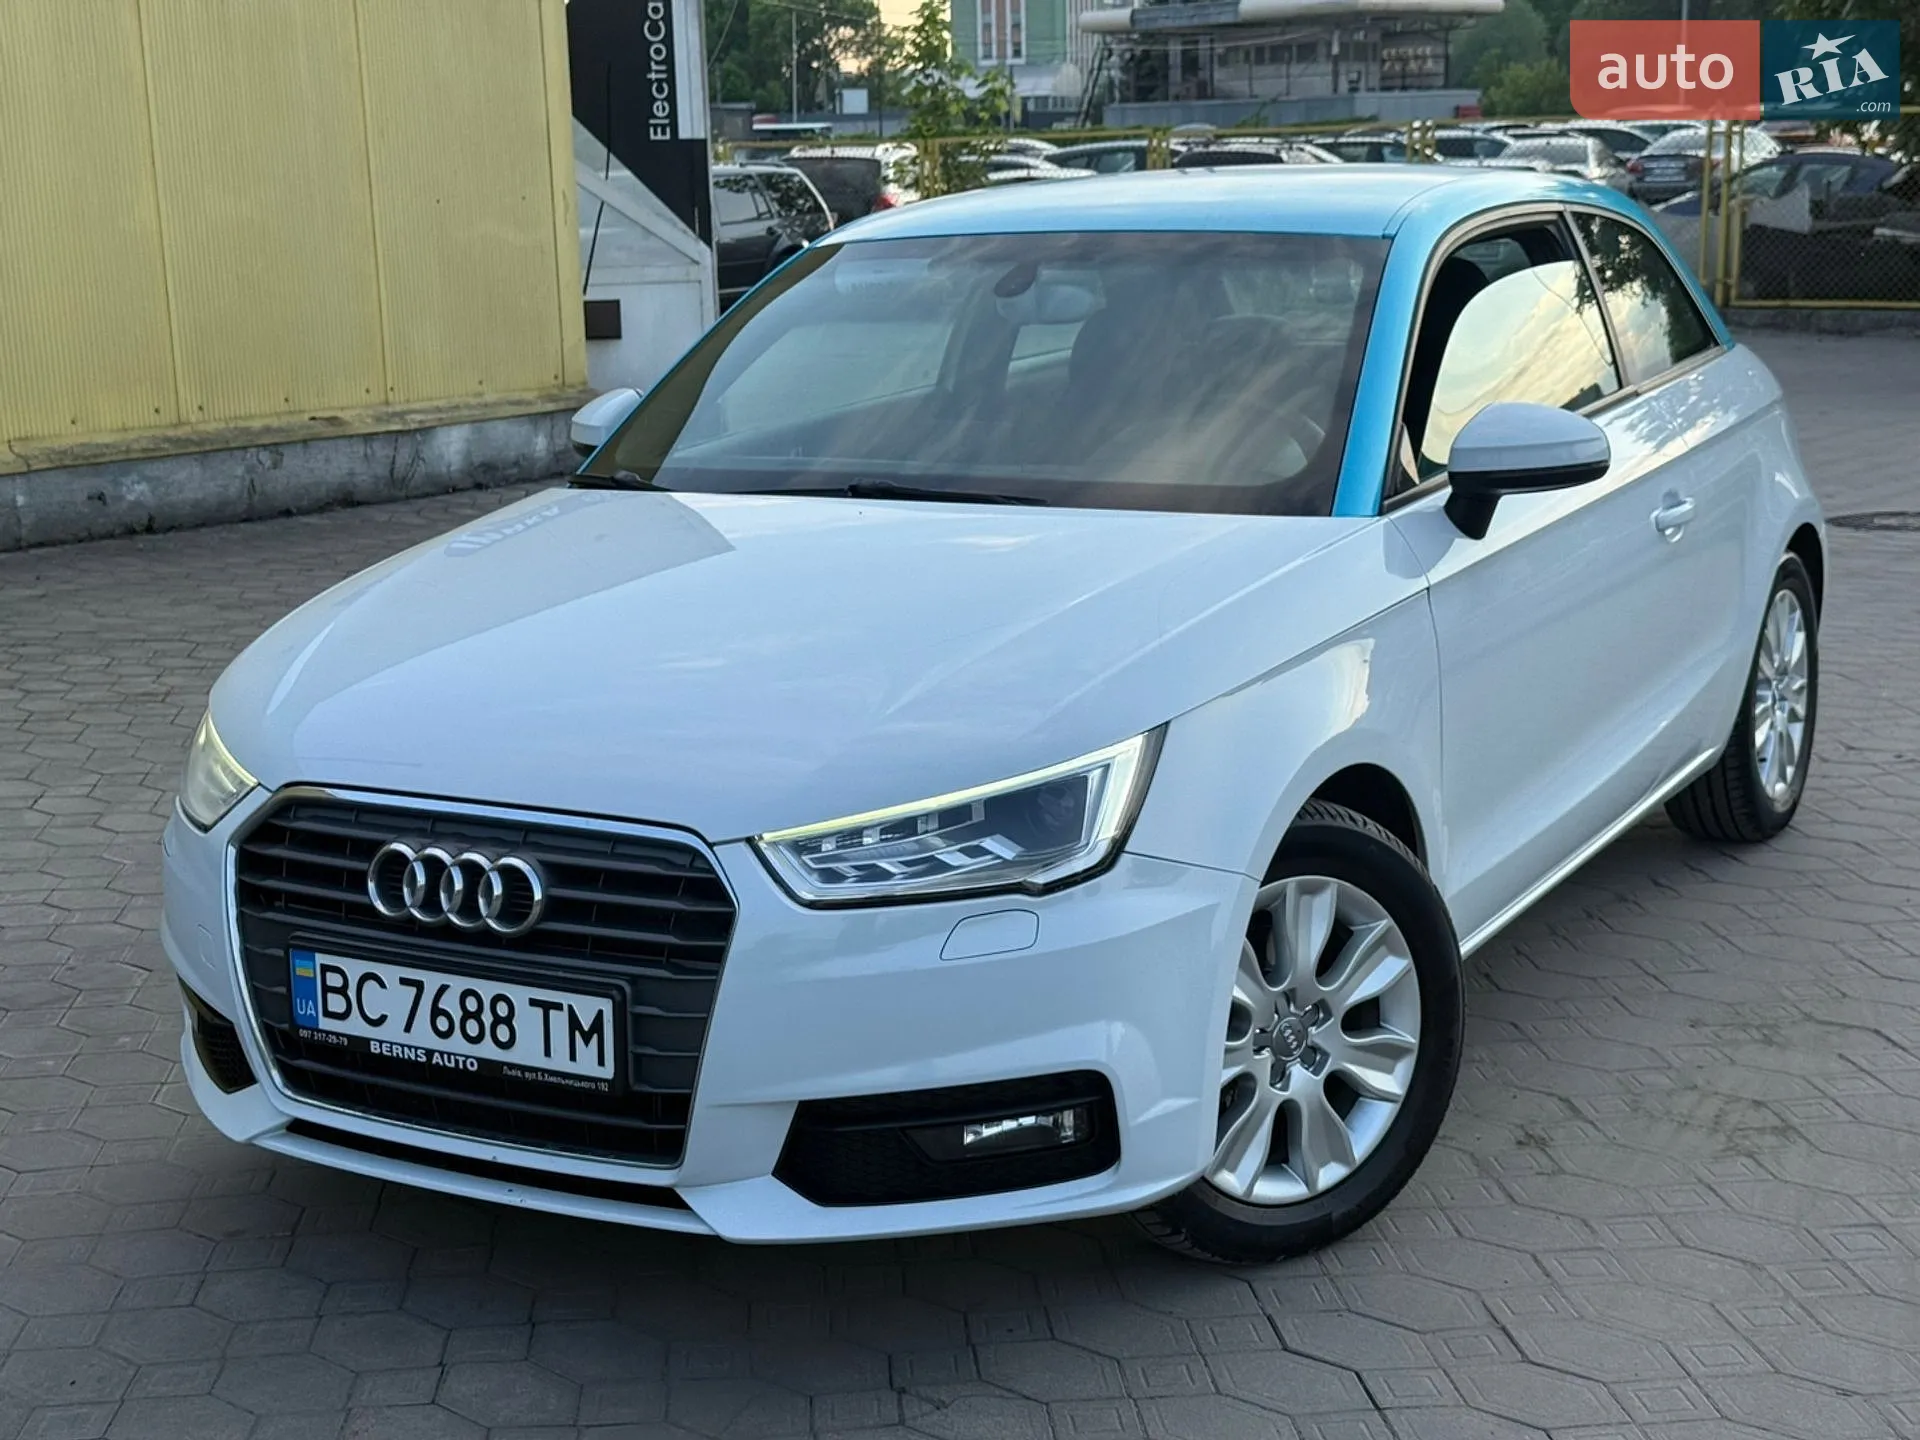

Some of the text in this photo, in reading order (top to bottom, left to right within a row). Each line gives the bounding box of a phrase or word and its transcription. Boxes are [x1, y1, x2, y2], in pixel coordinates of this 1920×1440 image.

[296, 998, 316, 1017] UA
[319, 963, 606, 1068] BC 7688 TM
[369, 1040, 478, 1072] BERNS AUTO
